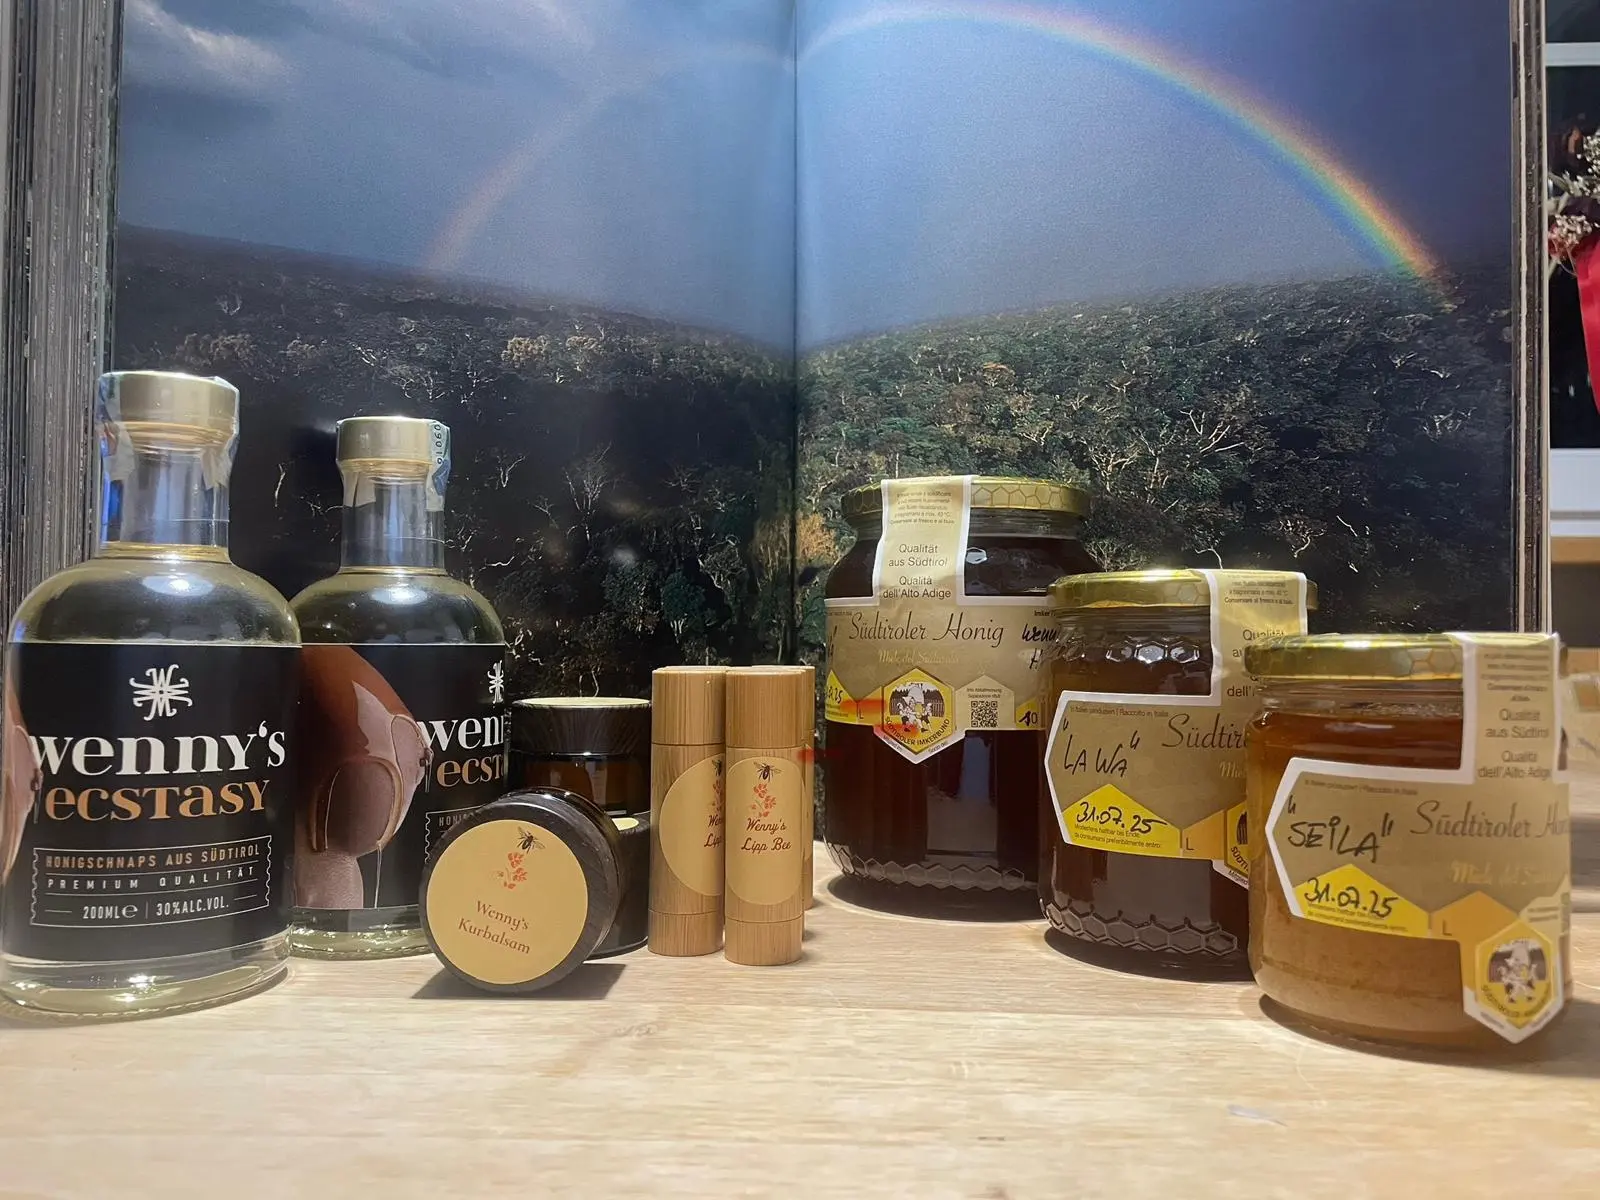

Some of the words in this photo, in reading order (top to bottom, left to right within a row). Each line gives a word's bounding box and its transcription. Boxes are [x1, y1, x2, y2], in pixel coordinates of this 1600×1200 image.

[899, 544, 938, 554] Qualität
[888, 559, 905, 567] aus
[908, 556, 948, 567] Südtirol
[899, 575, 933, 586] Qualità
[883, 588, 920, 599] dell'Alto
[922, 588, 952, 600] Adige
[848, 611, 927, 640] Südtiroler
[932, 611, 1004, 648] Honig
[916, 718, 950, 746] IMKERBUND
[746, 817, 788, 834] Wenny's
[1077, 801, 1168, 834] 31.07.25
[1409, 799, 1532, 839] Südtiroler
[741, 837, 768, 854] Lipp
[771, 837, 792, 851] Bee
[1185, 837, 1194, 850] L
[45, 854, 156, 869] HONIGSCHNAPS
[165, 852, 193, 866] AUS
[201, 843, 260, 863] SÜDTIROL
[48, 879, 138, 890] PREMIUM
[159, 866, 255, 887] QUALITÄT
[156, 895, 229, 917] 30%ALC.VOL.
[476, 900, 530, 932] Wenny's
[458, 917, 530, 954] Kurbalsam
[1443, 920, 1453, 936] L
